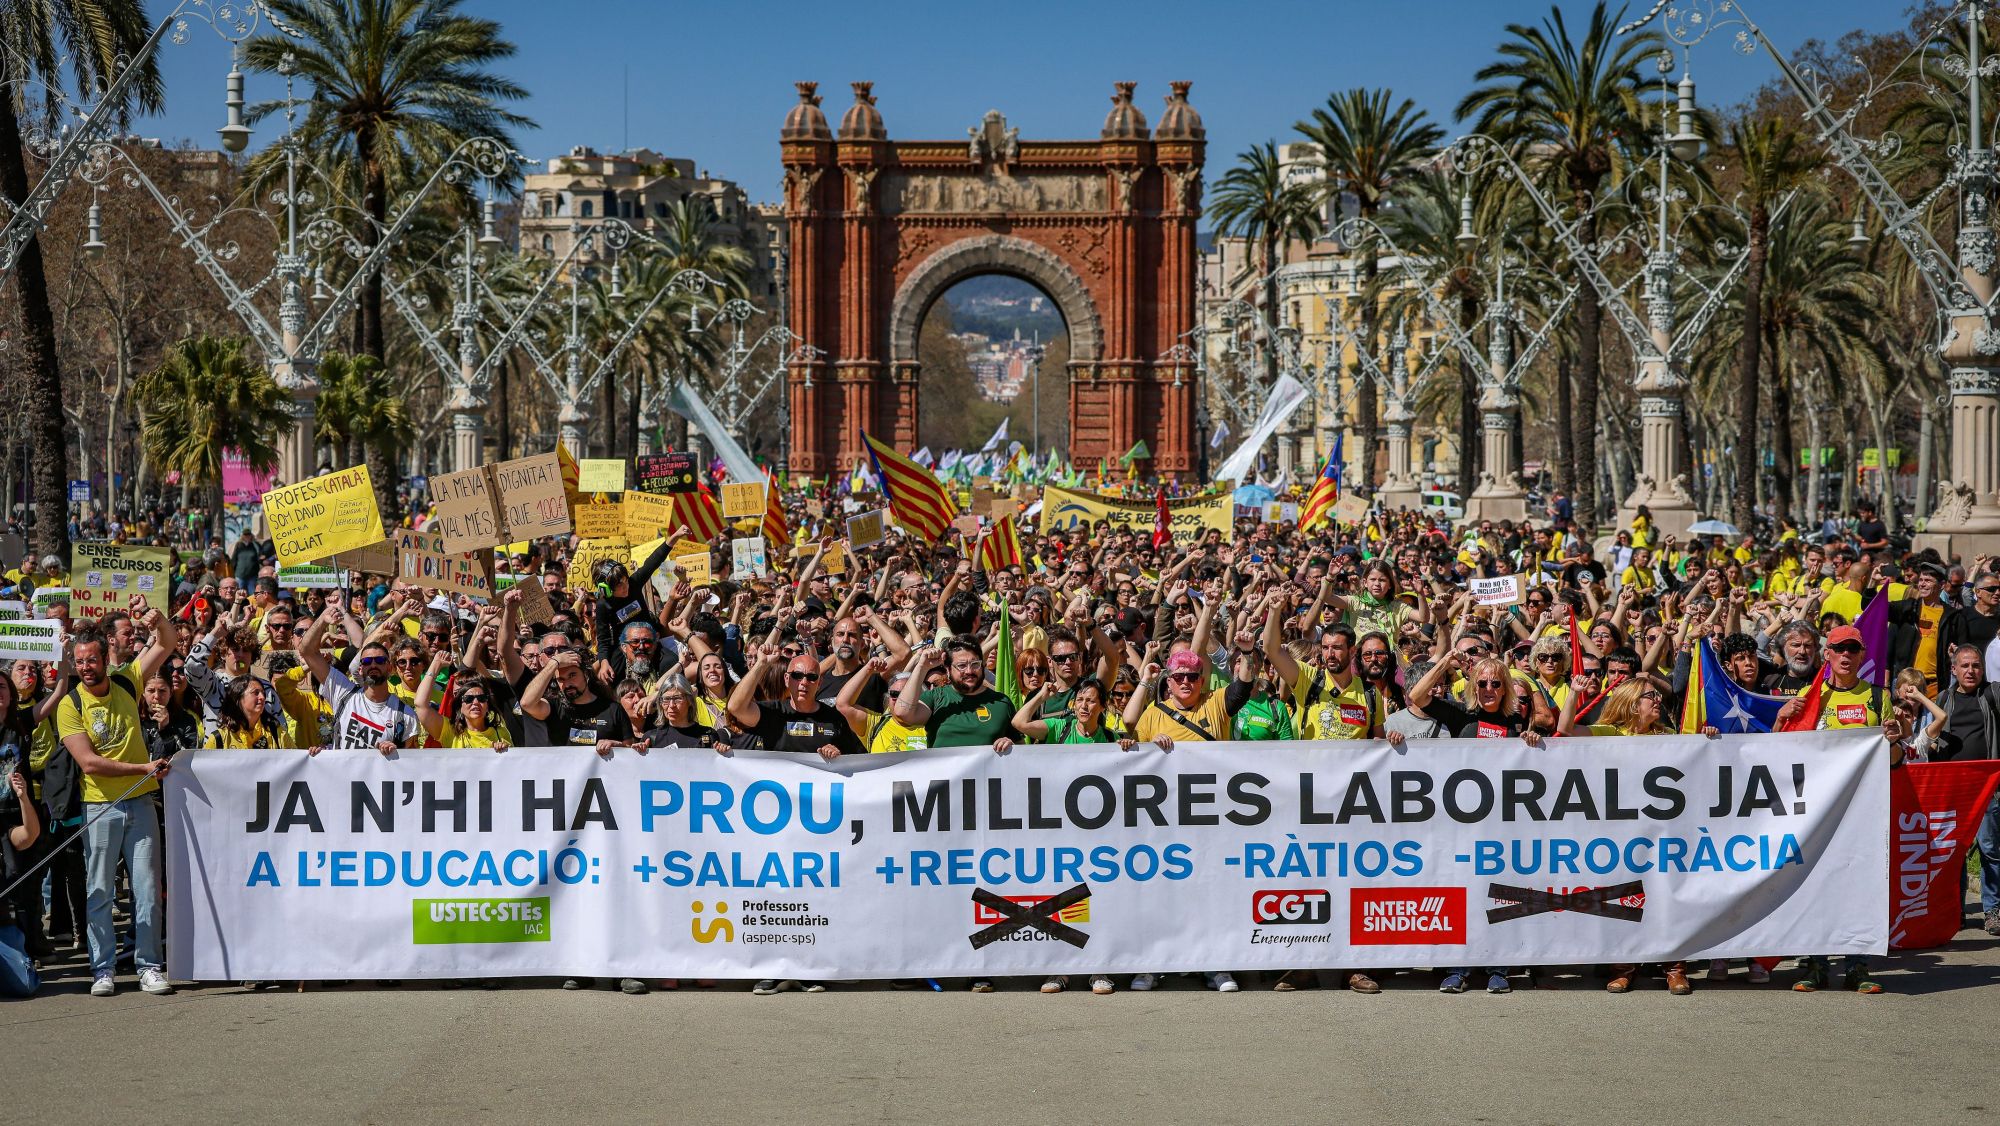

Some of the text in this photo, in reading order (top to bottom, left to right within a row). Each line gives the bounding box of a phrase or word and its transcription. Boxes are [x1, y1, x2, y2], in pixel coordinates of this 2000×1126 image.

[434, 482, 451, 503] LA
[453, 473, 486, 499] MEVA
[264, 482, 317, 513] PROFES
[269, 503, 325, 530] SOM DAVID
[440, 496, 567, 539] VAL MÉS QUE 100€
[1106, 509, 1132, 523] MÉS
[275, 524, 309, 541] CONTRA
[78, 544, 121, 558] SENSE
[92, 557, 163, 572] RECURSOS
[72, 588, 92, 601] NO
[103, 590, 117, 602] HI
[9, 625, 54, 638] PROFESSIÓ
[19, 641, 28, 651] LES
[347, 718, 383, 748] EAT
[245, 763, 1806, 846] JA N'HI HA PROU, MILLORES LABORALS JA!
[246, 826, 1804, 888] A L'EDUCACIÓ: +SALARI +RECURSOS -RÀTIOS -BUROCRÀCIA
[742, 900, 809, 912] Professors
[1257, 894, 1326, 921] CGT
[1363, 900, 1418, 917] INTER
[742, 914, 829, 926] de Secundària
[1363, 915, 1453, 932] SINDICAL
[524, 923, 543, 935] IAC
[1250, 928, 1332, 948] Ensenyament
